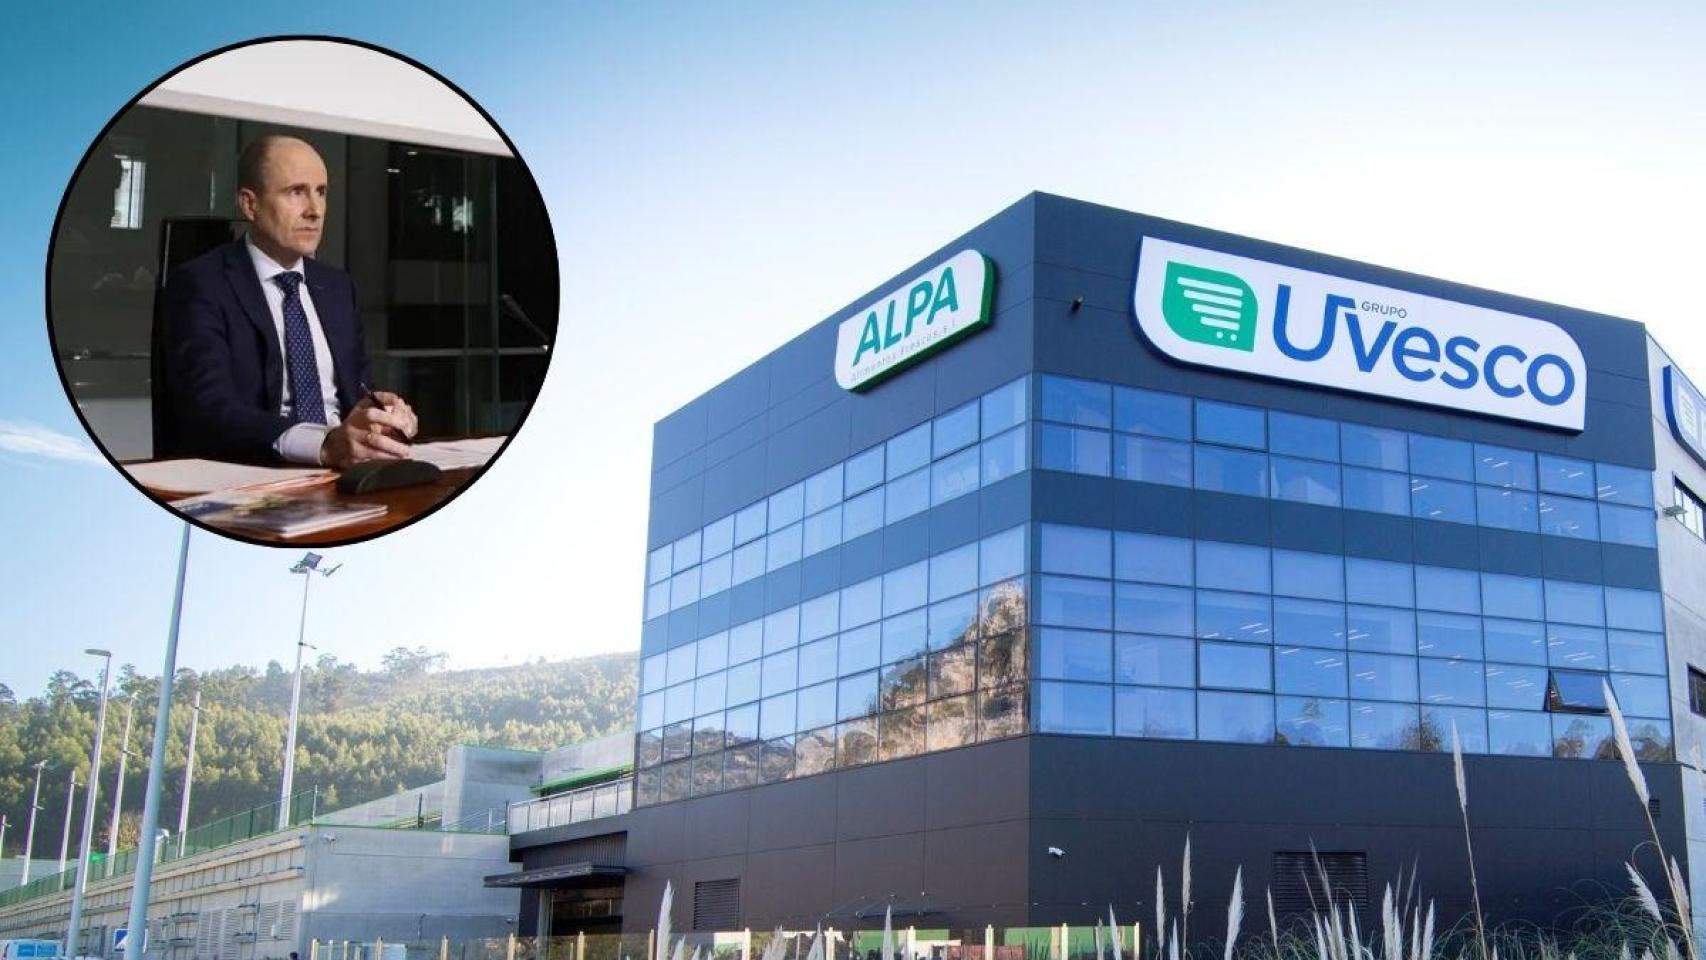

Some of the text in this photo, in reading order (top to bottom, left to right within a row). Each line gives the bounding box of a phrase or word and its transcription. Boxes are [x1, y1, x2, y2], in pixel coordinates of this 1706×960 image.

[852, 267, 959, 367] ALPA
[1273, 284, 1576, 406] Uvesco
[1361, 300, 1408, 319] GRUPO
